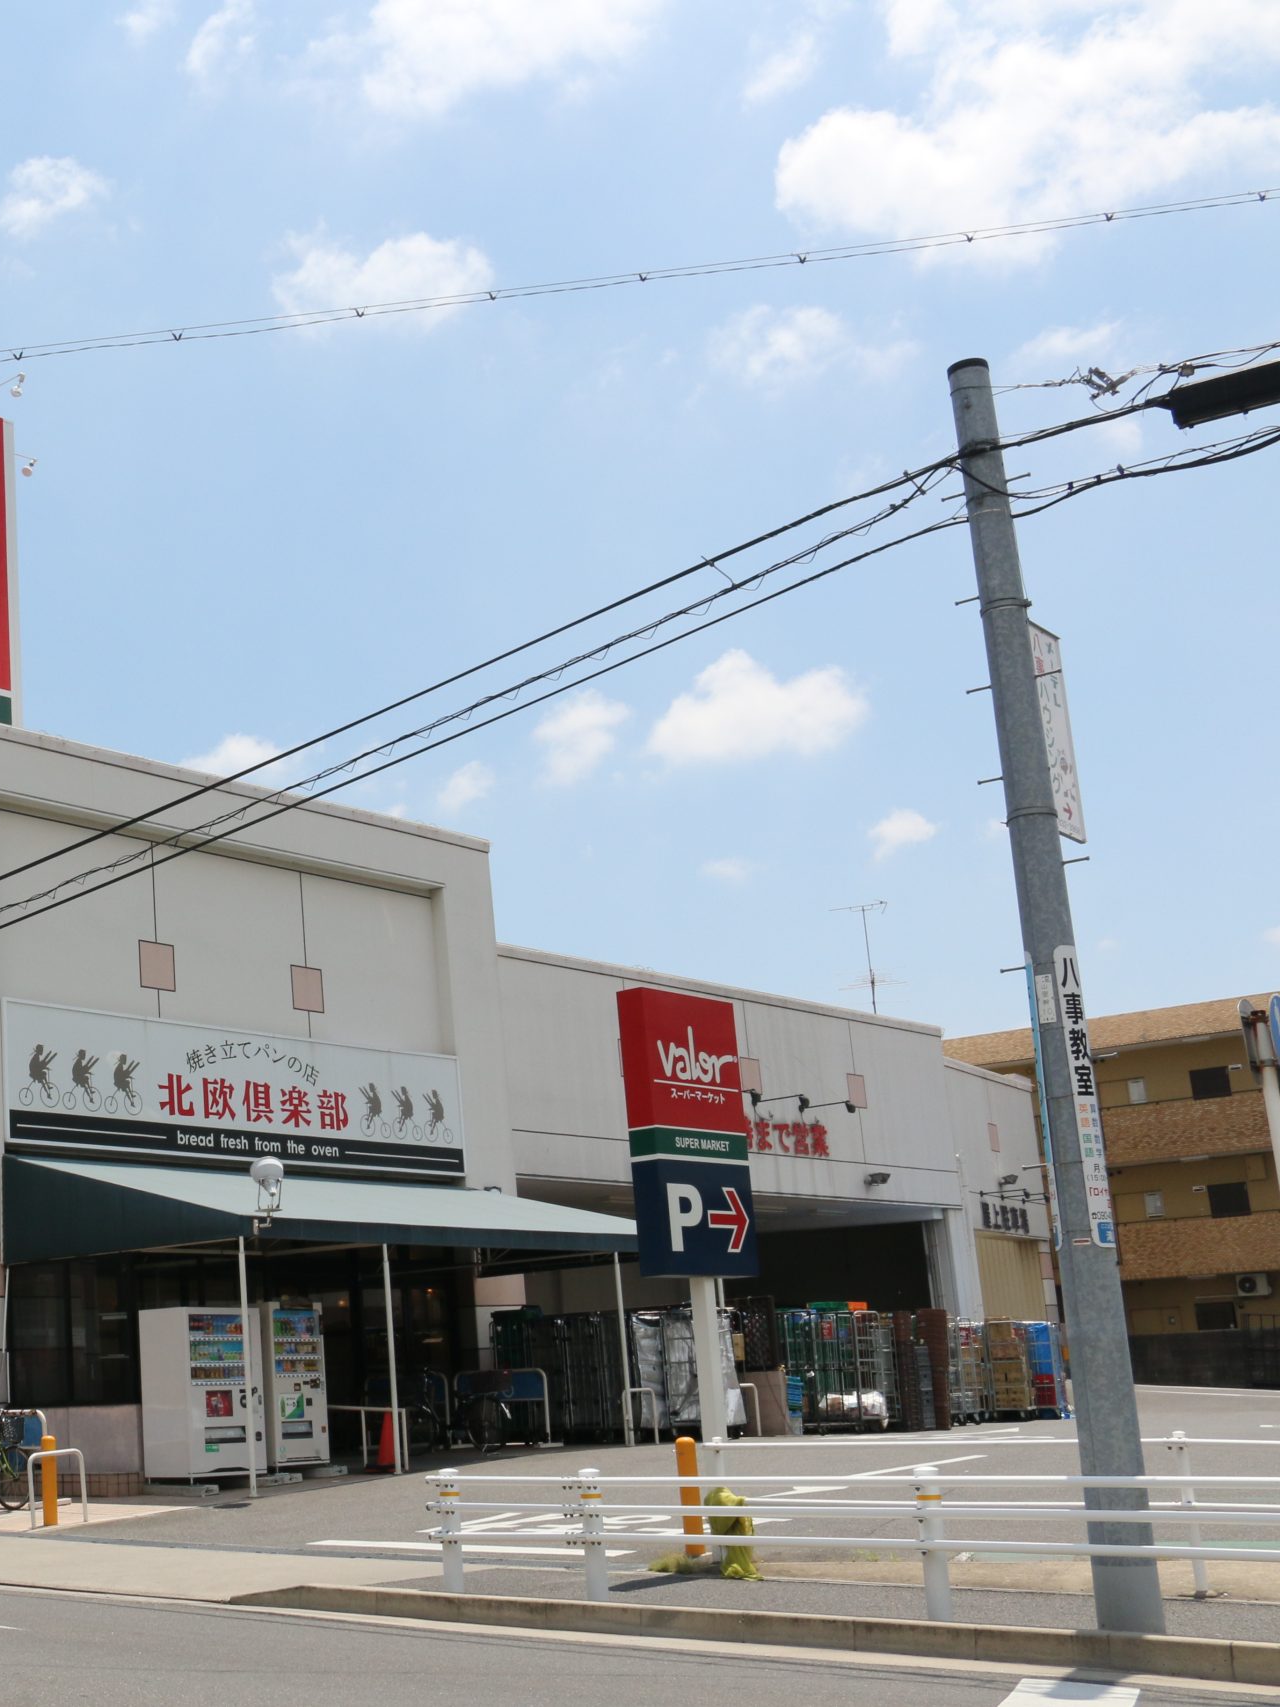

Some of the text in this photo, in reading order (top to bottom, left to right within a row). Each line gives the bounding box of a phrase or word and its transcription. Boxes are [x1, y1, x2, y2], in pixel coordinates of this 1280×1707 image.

[1061, 957, 1095, 1096] 八事教室
[185, 1039, 320, 1087] 焼き立てパンの店
[157, 1073, 349, 1131] 北欧倶楽部
[671, 1088, 726, 1104] スーパーマーケット
[177, 1130, 339, 1157] bread fresh from the oven
[675, 1136, 730, 1152] SUPER MARKET
[666, 1182, 703, 1252] P
